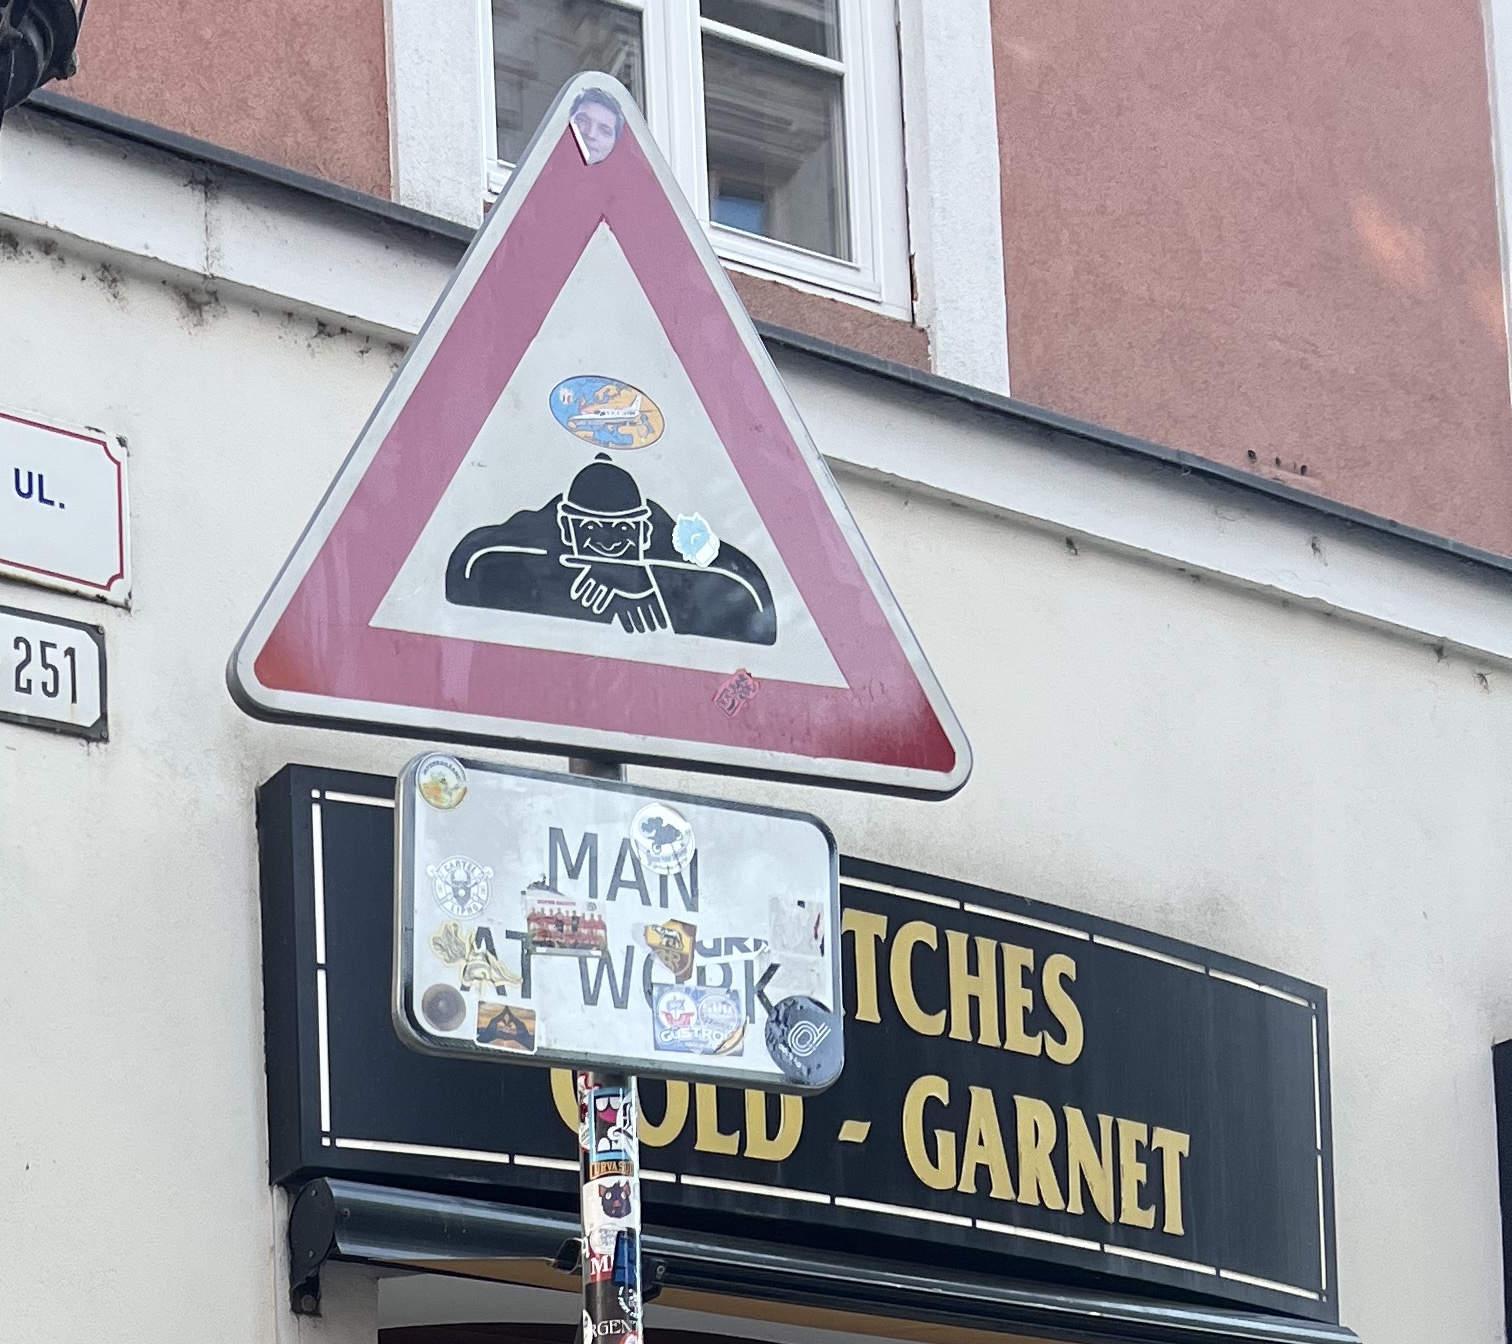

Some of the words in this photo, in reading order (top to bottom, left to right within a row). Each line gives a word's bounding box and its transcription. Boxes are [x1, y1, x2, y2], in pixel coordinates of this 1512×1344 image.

[14, 467, 66, 510] UL.
[13, 636, 78, 704] 251
[548, 826, 700, 912] MAN
[460, 926, 534, 1000] AT
[841, 907, 1085, 1065] TCHES
[550, 1066, 806, 1162] OLD
[903, 1075, 1190, 1236] GARNET
